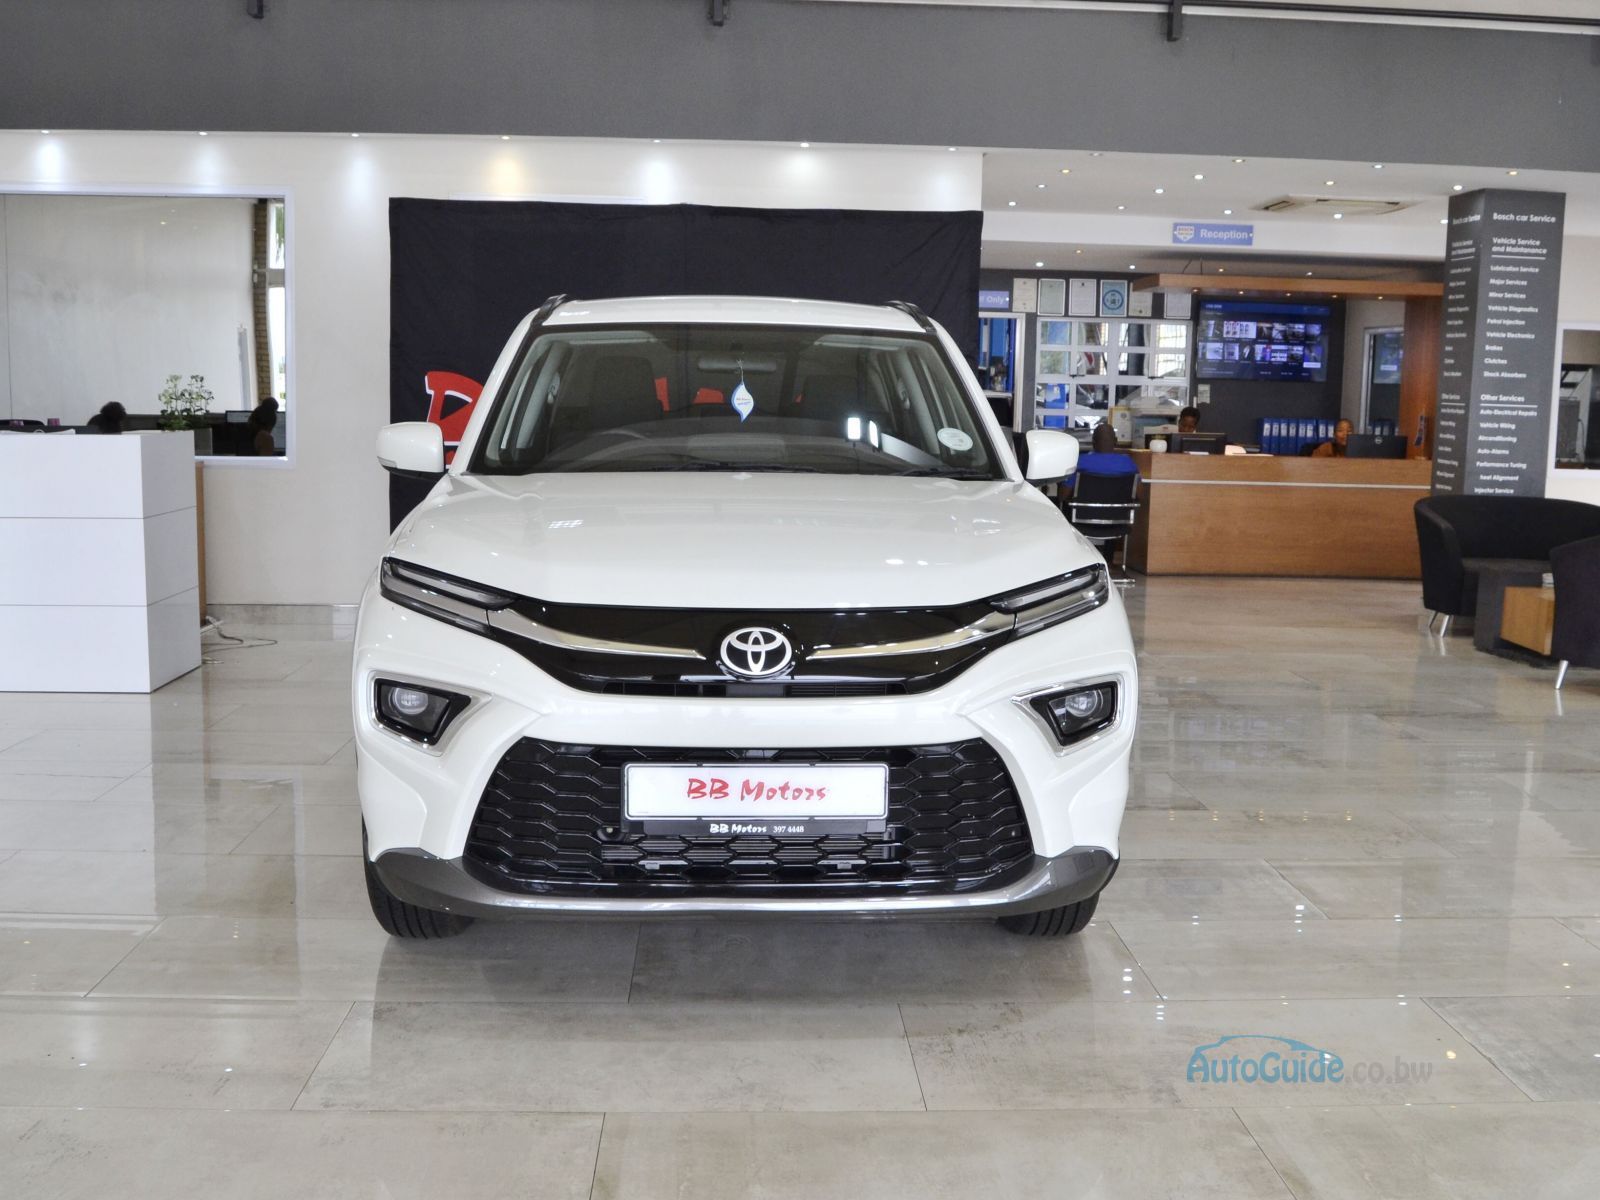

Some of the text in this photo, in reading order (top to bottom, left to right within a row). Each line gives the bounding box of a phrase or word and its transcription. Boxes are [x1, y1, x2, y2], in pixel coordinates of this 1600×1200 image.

[1493, 212, 1515, 221] Bosch
[1530, 214, 1556, 223] Service
[1200, 228, 1248, 240] Reception
[1492, 237, 1541, 246] Vehicle Service
[986, 295, 1004, 305] Only
[1484, 357, 1508, 365] Clutches
[1499, 394, 1525, 402] Services
[1495, 487, 1514, 495] Service
[687, 778, 827, 802] BB Motors
[710, 823, 804, 834] BB Motors 397 4448
